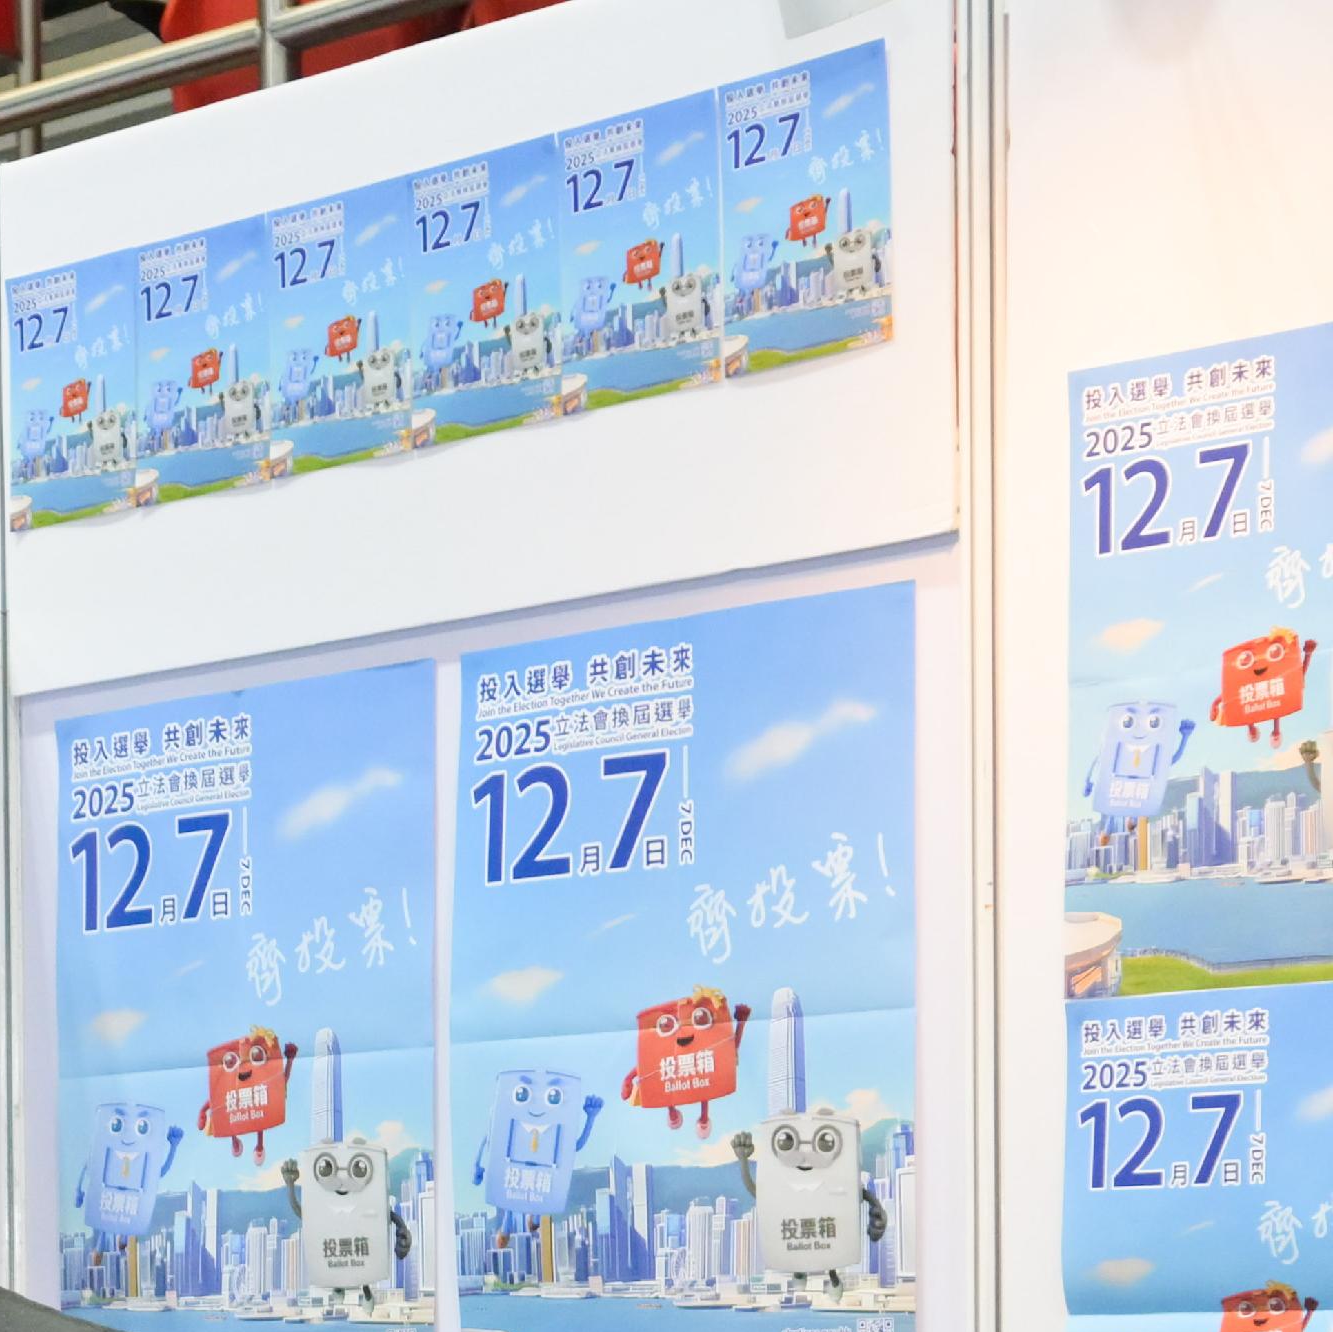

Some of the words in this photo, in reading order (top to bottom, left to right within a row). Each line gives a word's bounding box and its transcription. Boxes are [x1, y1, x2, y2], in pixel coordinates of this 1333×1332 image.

[479, 665, 571, 702] 投入選舉
[588, 645, 693, 683] 共創未來
[73, 730, 149, 766] 投入選舉
[164, 715, 251, 749] 共創未來
[680, 820, 693, 864] DEC
[238, 875, 253, 913] DEC
[1083, 1016, 1164, 1044] 投入選舉
[1180, 1010, 1267, 1037] 共創未來
[659, 1050, 715, 1080] 投票箱
[225, 1084, 269, 1113] 投票箱
[664, 1077, 691, 1093] Ballot
[691, 1076, 711, 1090] Box
[780, 1216, 837, 1240] 投票箱
[323, 1235, 370, 1259] 投票箱
